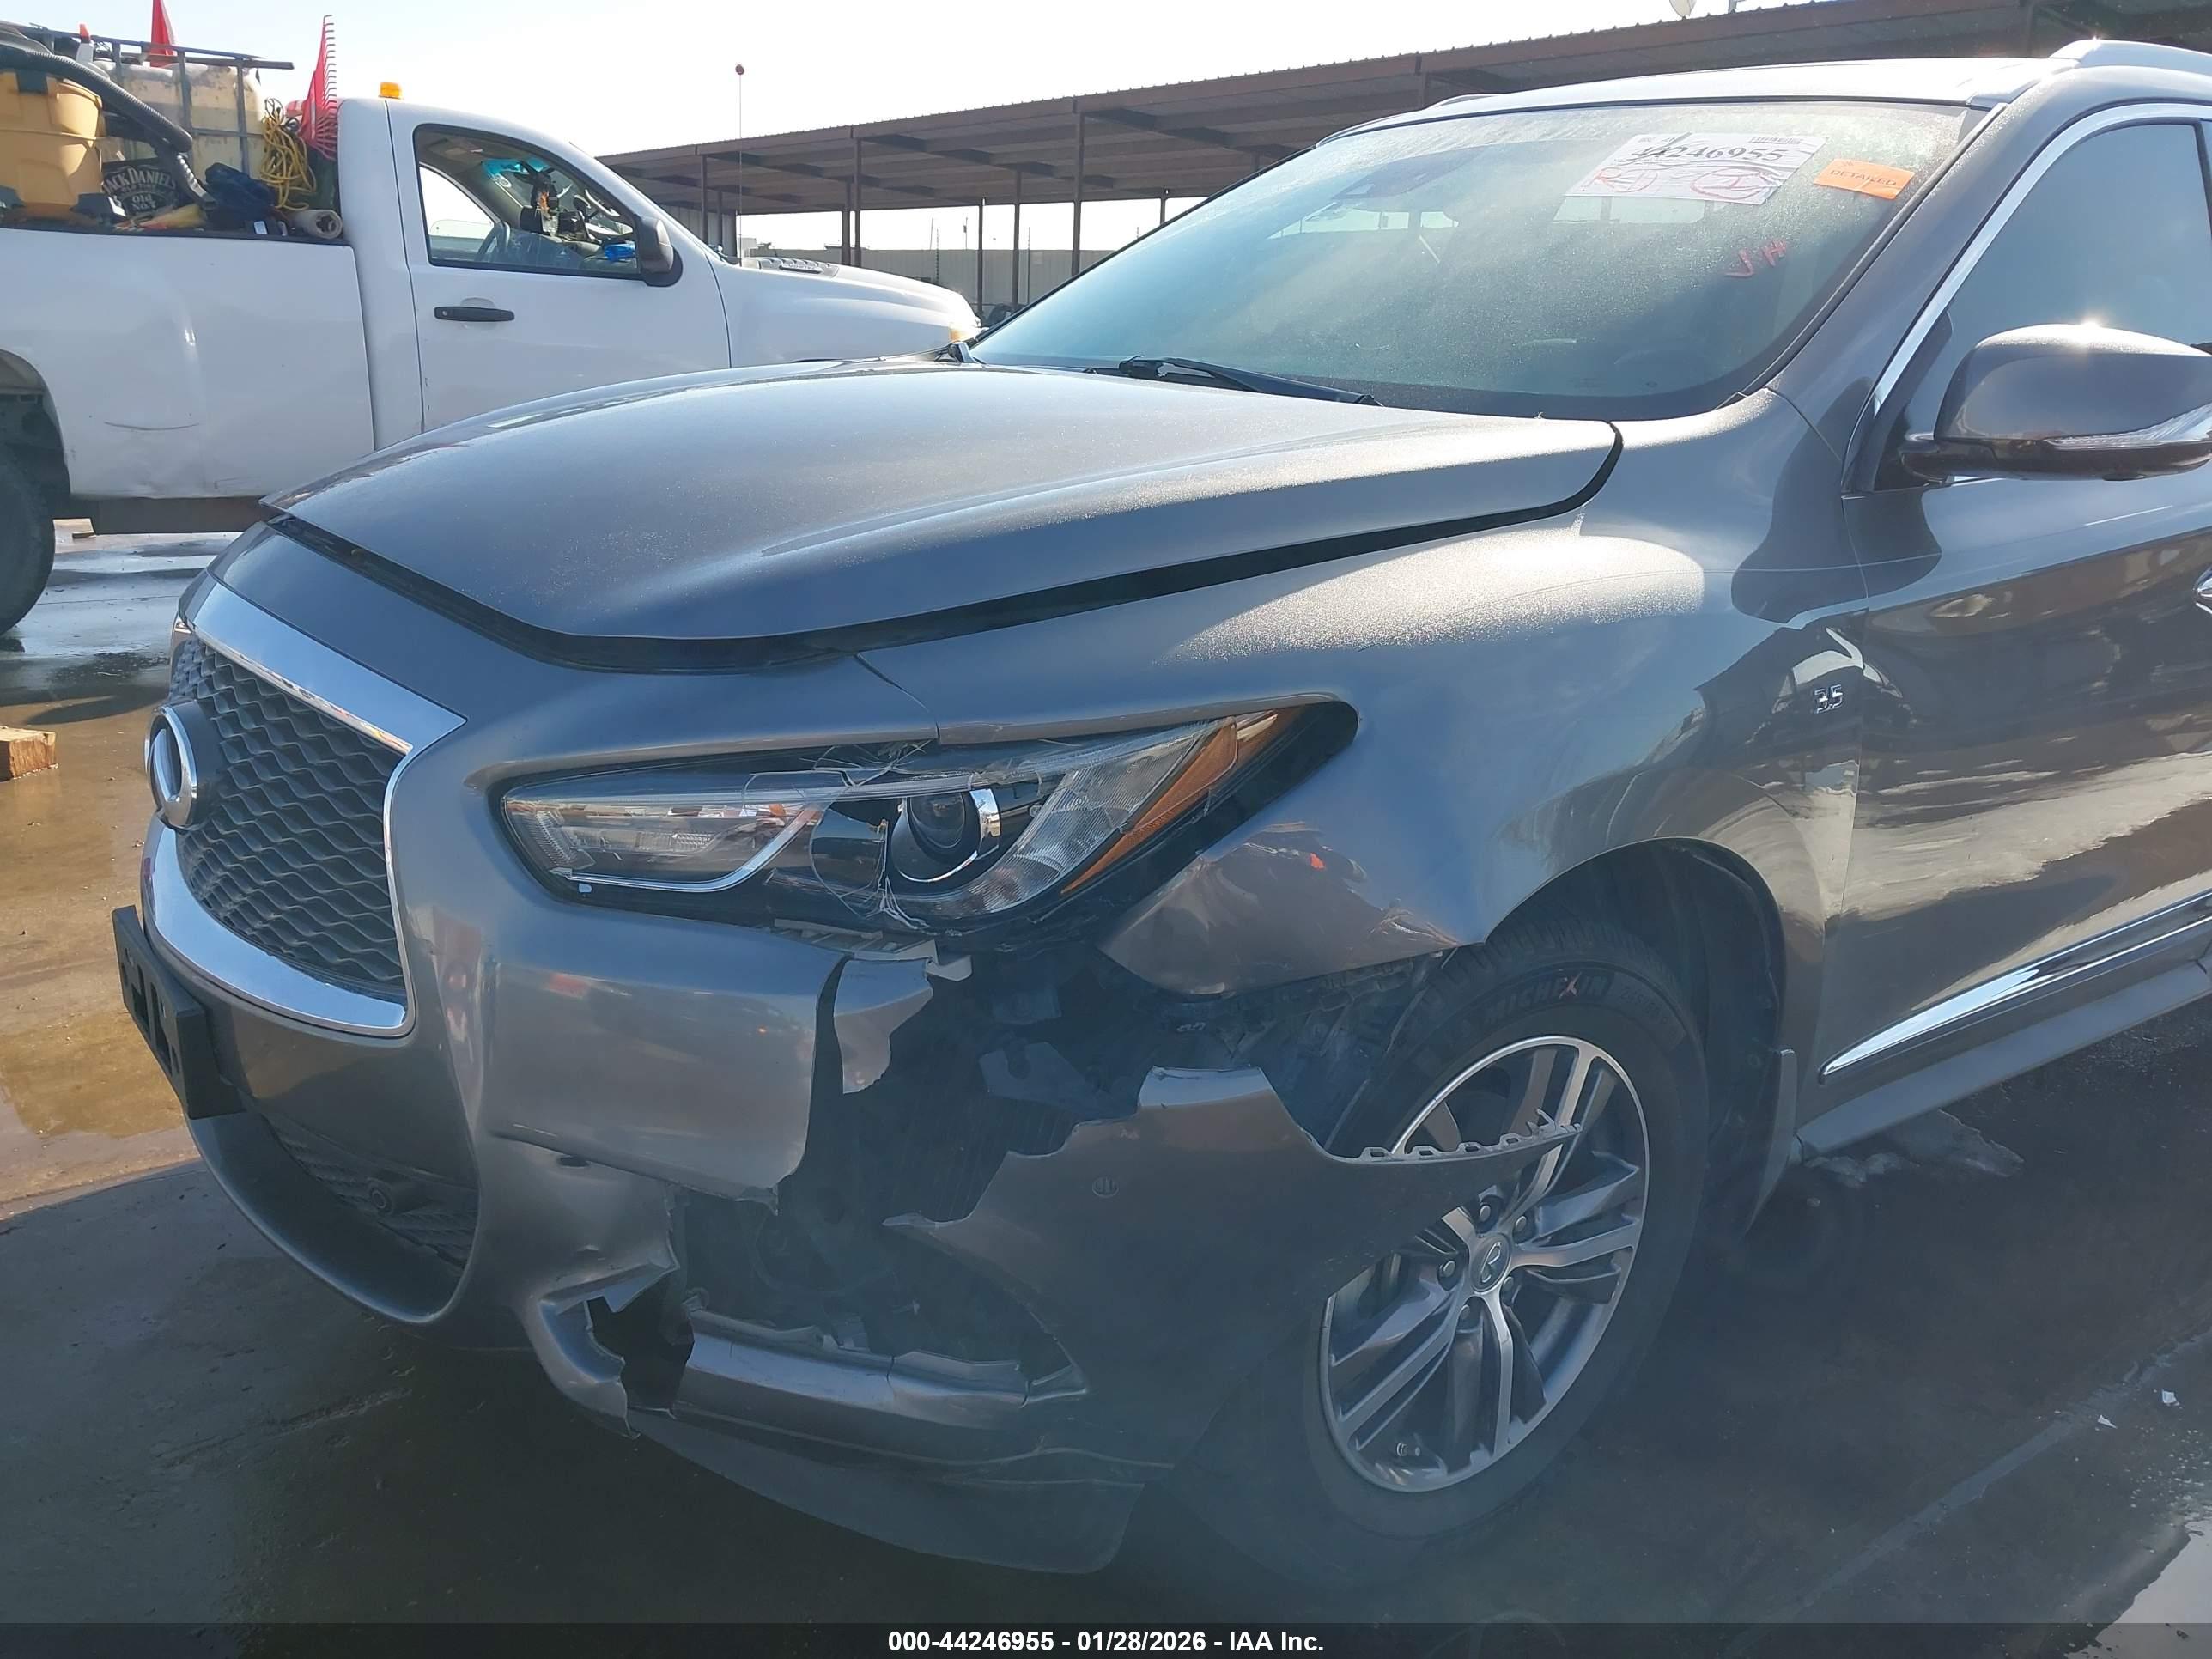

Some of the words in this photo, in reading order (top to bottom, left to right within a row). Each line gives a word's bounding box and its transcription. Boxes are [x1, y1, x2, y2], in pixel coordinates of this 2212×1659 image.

[1829, 169, 1897, 185] DETAILED
[1814, 684, 1844, 714] 3.5
[1484, 974, 1609, 1023] MICHEIN
